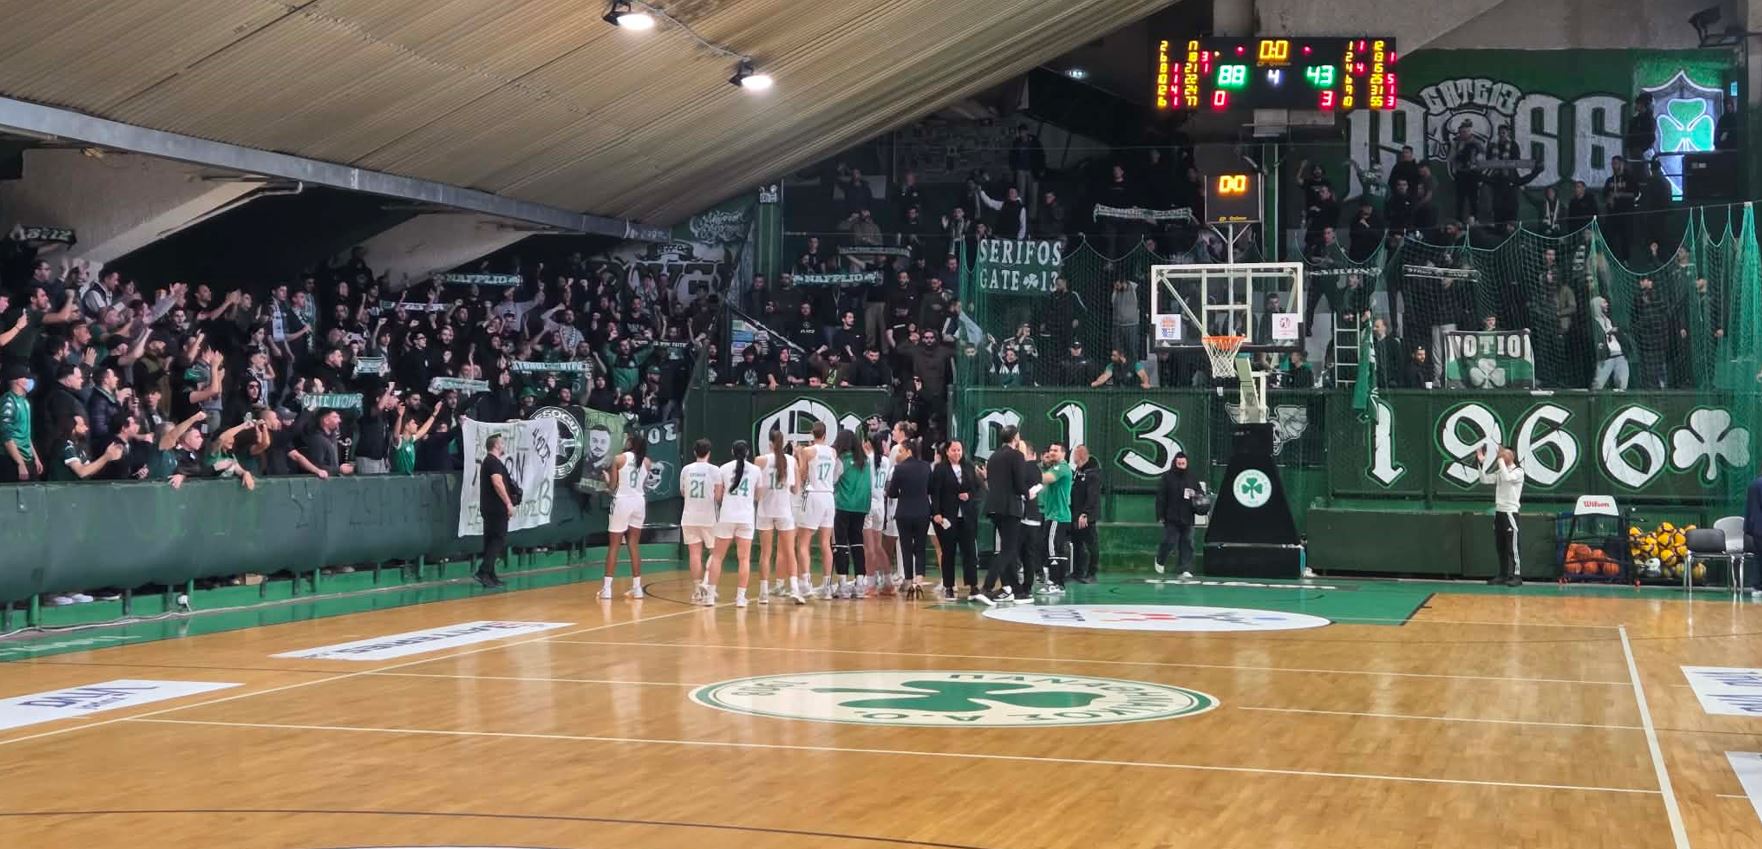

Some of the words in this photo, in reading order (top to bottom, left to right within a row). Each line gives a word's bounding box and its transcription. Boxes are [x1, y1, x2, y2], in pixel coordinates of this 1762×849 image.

[1160, 40, 1168, 51] 2
[1188, 40, 1198, 50] 17
[1160, 52, 1167, 62] 6
[1201, 51, 1208, 61] 3
[1345, 52, 1353, 62] 2
[1184, 63, 1198, 73] 21
[1345, 63, 1353, 73] 4
[1356, 62, 1364, 72] 4
[1184, 74, 1198, 84] 22
[1218, 65, 1246, 86] 88
[1267, 69, 1280, 85] 4
[1306, 65, 1335, 86] 43
[1345, 75, 1353, 84] 6
[1387, 73, 1394, 84] 5
[1171, 85, 1178, 94] 4
[1184, 85, 1198, 95] 24
[1345, 85, 1353, 95] 9
[1370, 85, 1383, 95] 31
[1185, 96, 1198, 106] 77
[1214, 90, 1226, 106] 0
[1321, 90, 1333, 106] 3
[1387, 96, 1394, 106] 3
[1345, 94, 1626, 201] 1966
[979, 239, 1061, 266] SERIFOS
[980, 268, 1020, 291] GATE
[1041, 271, 1059, 292] 13
[1056, 402, 1183, 475] 13
[1372, 402, 1666, 488] 1966
[818, 463, 831, 480] 17
[875, 471, 885, 489] 10
[690, 480, 705, 498] 21
